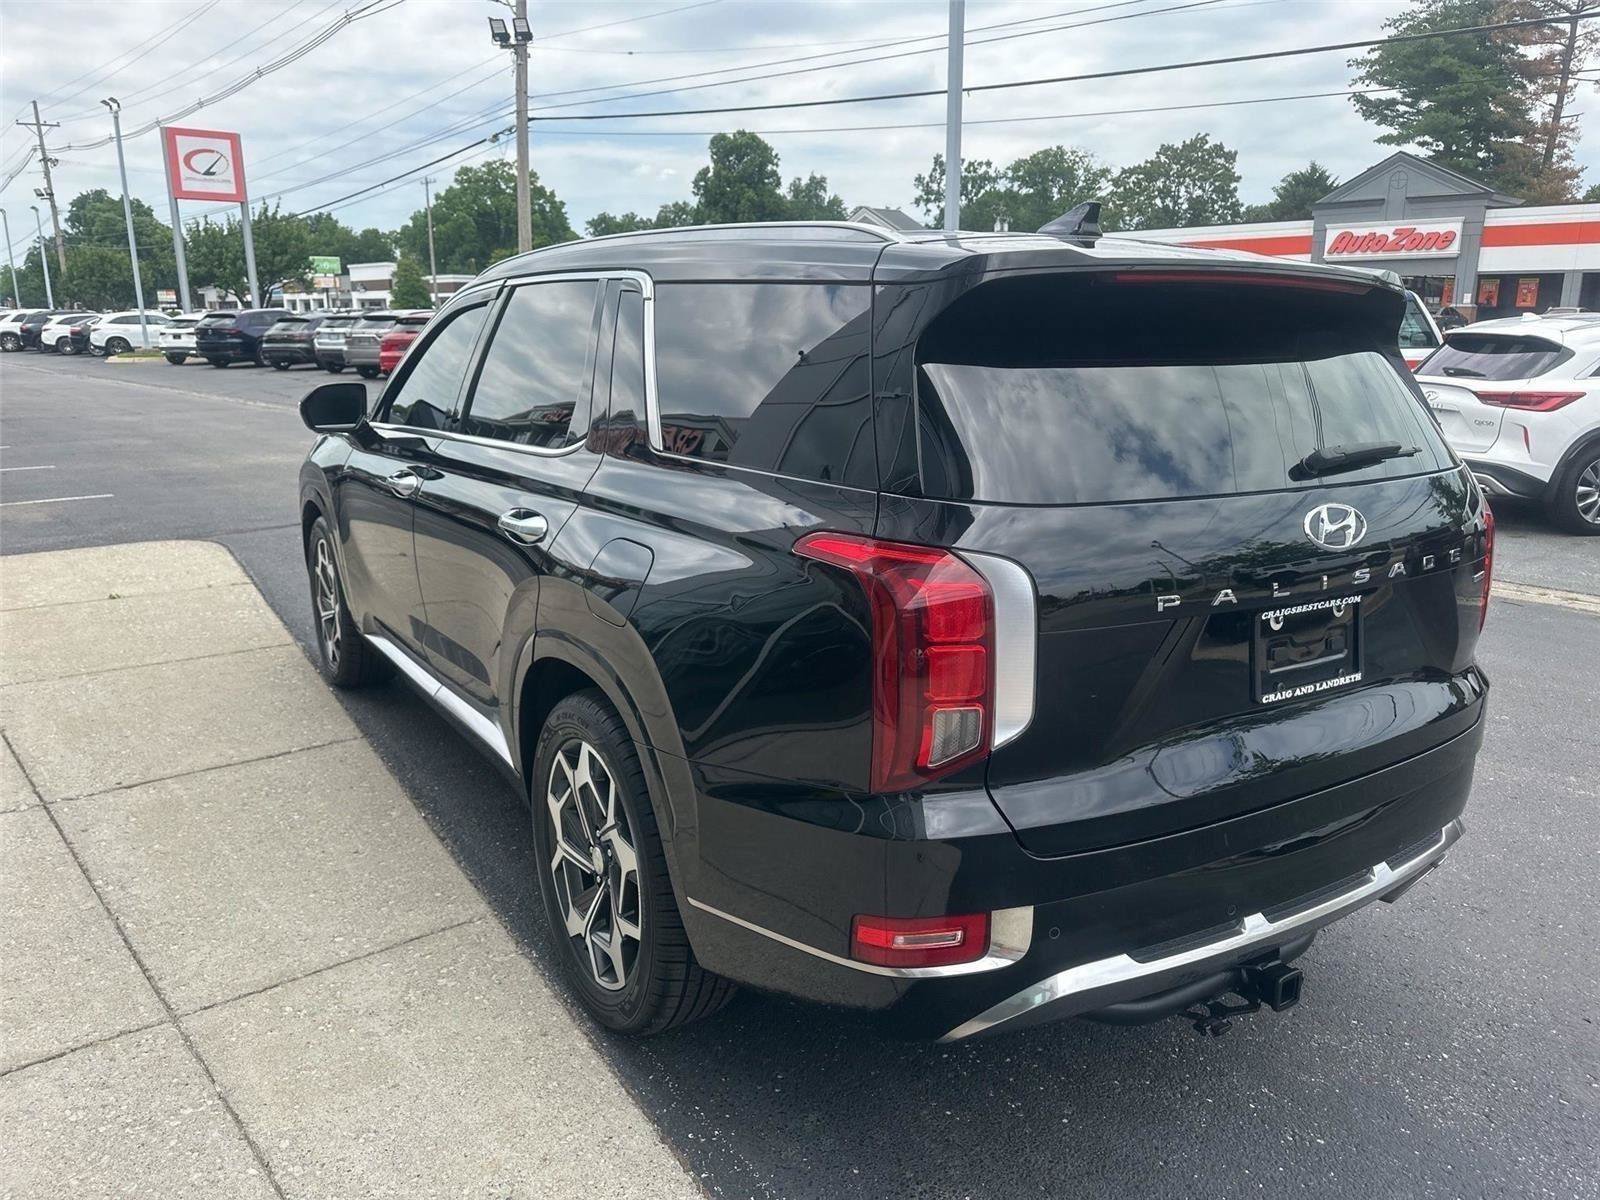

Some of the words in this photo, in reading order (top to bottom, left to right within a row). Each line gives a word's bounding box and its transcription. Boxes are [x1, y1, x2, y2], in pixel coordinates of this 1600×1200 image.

[1327, 228, 1457, 254] AutoZone
[1157, 547, 1461, 612] PALISADE
[1261, 595, 1362, 620] CRAIGSBESTCARS.COM
[1262, 689, 1293, 703] CRAIG
[1294, 684, 1315, 697] AND
[1316, 672, 1362, 691] LANDRETH
